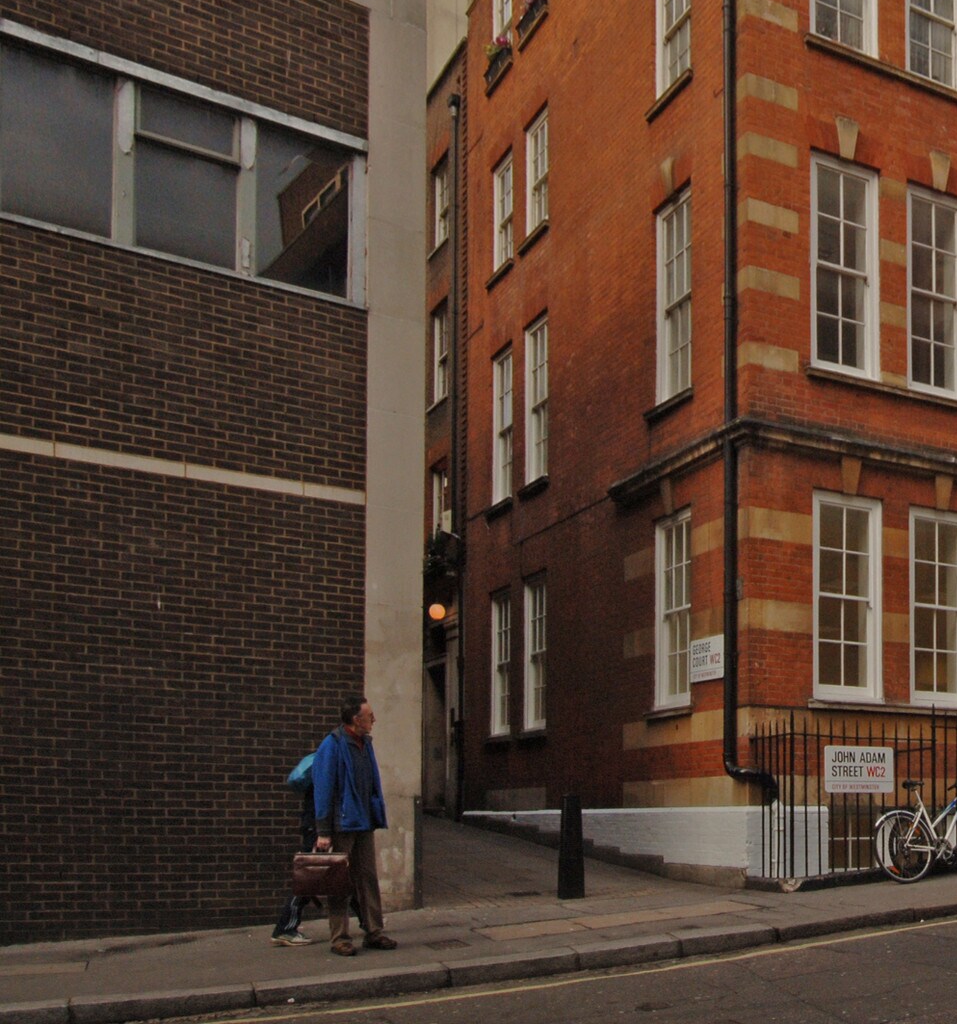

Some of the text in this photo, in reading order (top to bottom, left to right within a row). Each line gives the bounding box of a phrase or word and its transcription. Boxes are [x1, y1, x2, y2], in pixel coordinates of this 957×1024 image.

[692, 641, 711, 655] GEORGE
[692, 652, 721, 668] COURT WC2
[831, 751, 886, 764] JOHN ADAM
[831, 765, 886, 778] STREET WC2
